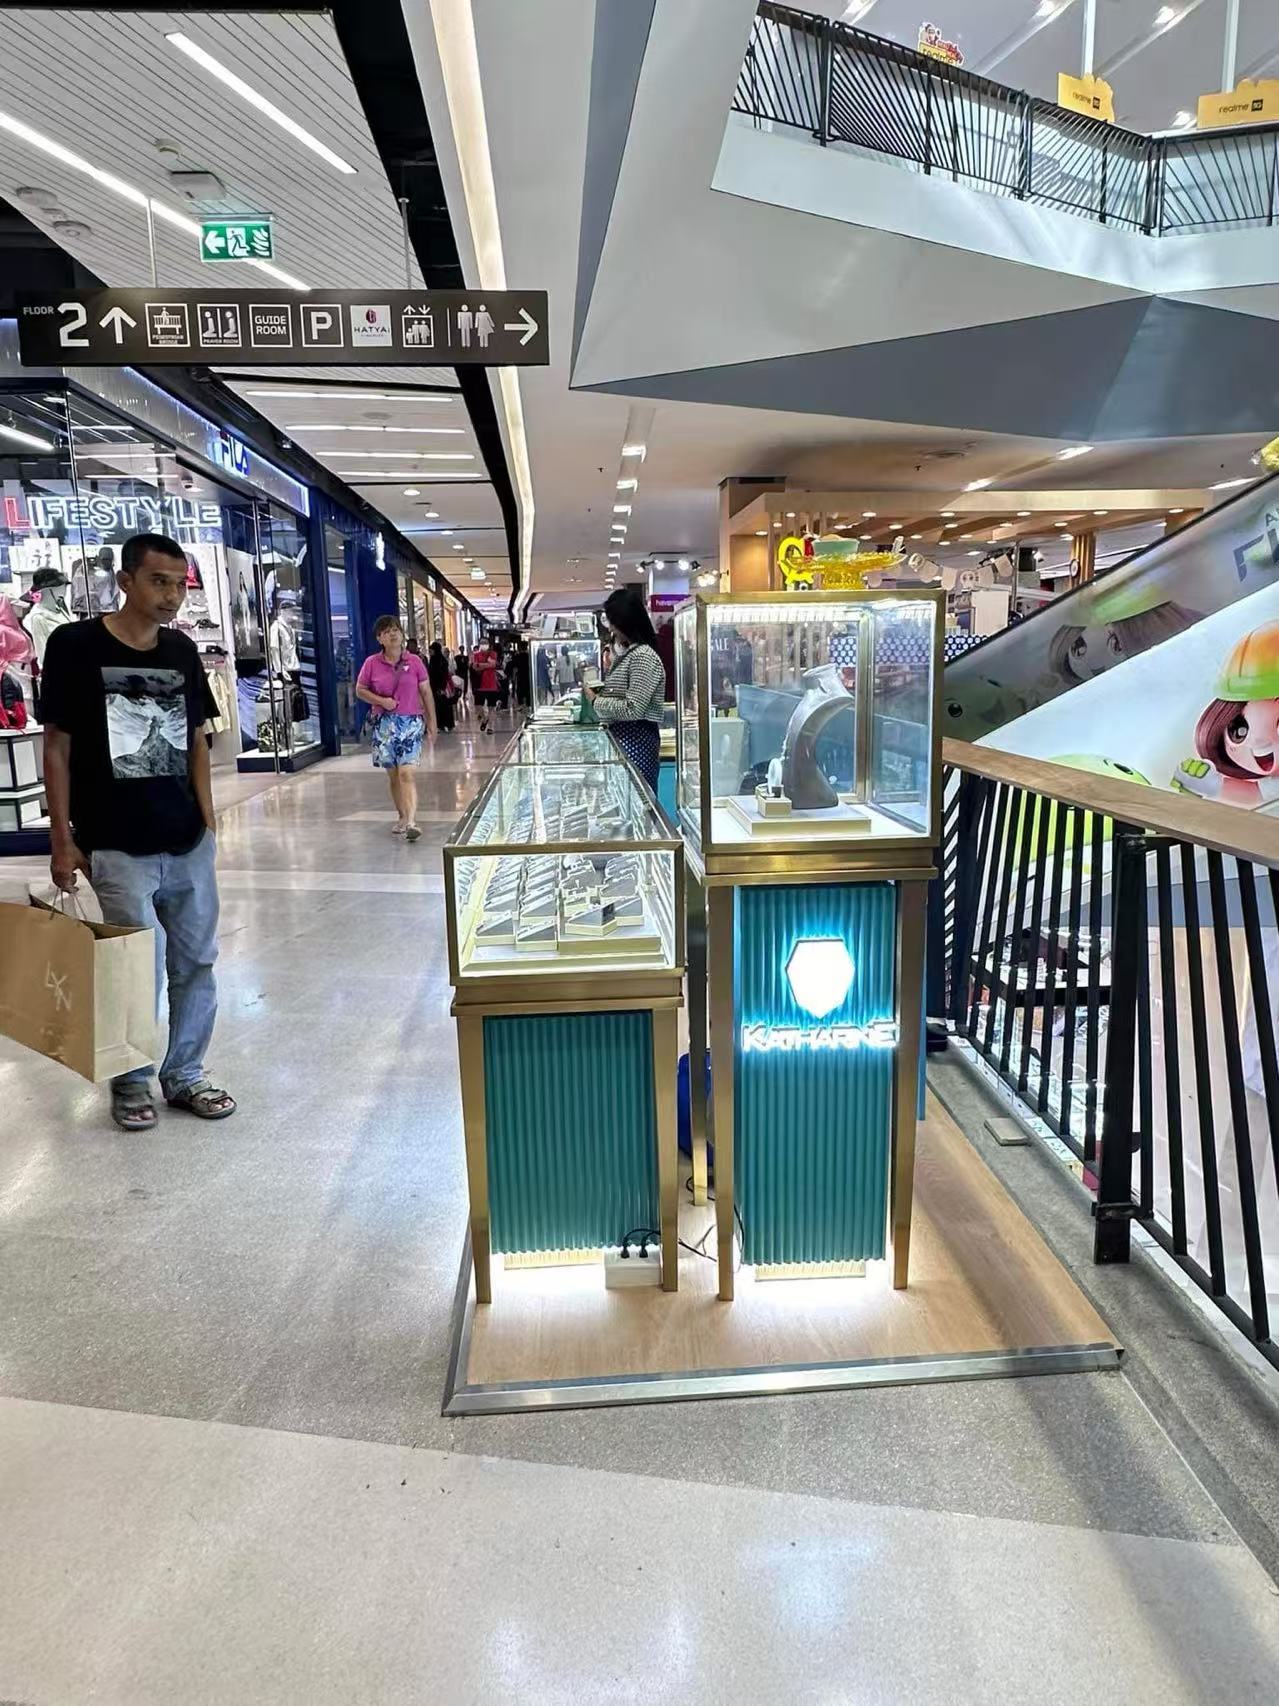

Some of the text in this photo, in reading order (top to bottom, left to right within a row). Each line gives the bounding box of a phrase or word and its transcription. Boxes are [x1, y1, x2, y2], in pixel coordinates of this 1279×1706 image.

[1218, 103, 1250, 113] realme
[23, 303, 89, 347] FLOOR 2
[254, 315, 287, 325] GUIDE
[311, 311, 333, 340] P
[256, 326, 287, 335] ROOM
[5, 496, 222, 530] LIFESTYLE
